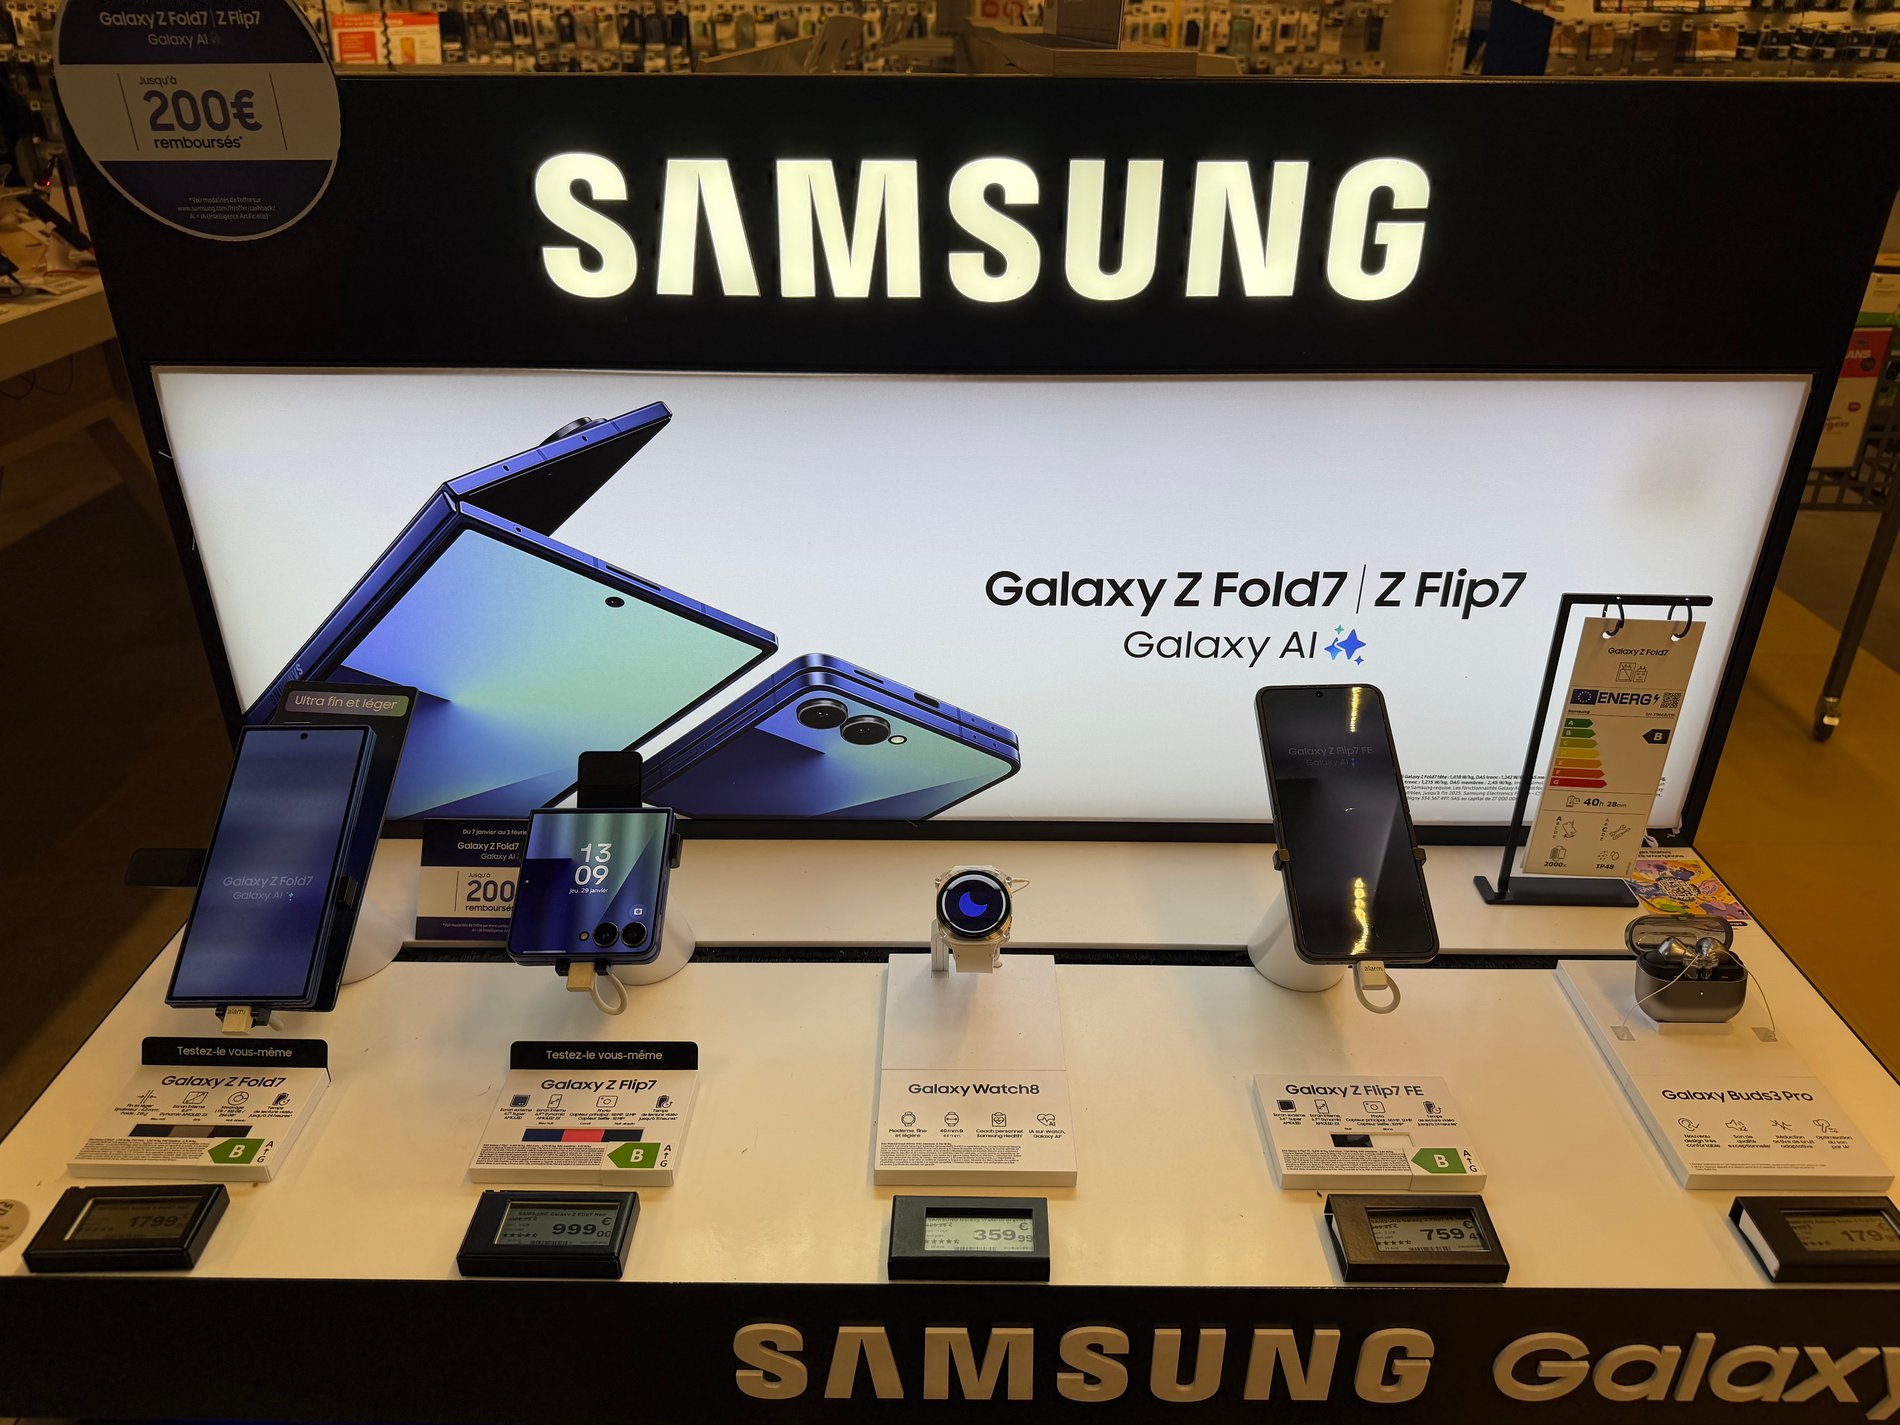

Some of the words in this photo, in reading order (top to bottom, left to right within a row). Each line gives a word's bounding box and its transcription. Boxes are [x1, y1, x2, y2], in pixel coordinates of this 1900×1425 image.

[100, 10, 154, 30] Galaxy
[156, 11, 168, 26] Z
[168, 10, 209, 26] Fold7
[216, 11, 227, 26] Z
[228, 10, 261, 30] Flip7
[148, 33, 194, 48] Galaxy
[196, 33, 209, 45] AI
[143, 89, 262, 132] 200€
[533, 151, 1432, 303] SAMSUNG
[986, 570, 1168, 616] Galaxy
[1172, 571, 1202, 608] Z
[1212, 570, 1348, 608] Fold7
[1374, 571, 1406, 608] Z
[1415, 568, 1528, 620] Flip7
[1122, 630, 1272, 668] Galaxy
[1279, 630, 1318, 659] AI
[1608, 647, 1639, 656] Galaxy
[1646, 648, 1669, 656] Fold7
[294, 695, 325, 706] Ultra
[327, 696, 344, 708] fin
[346, 698, 360, 708] et
[362, 697, 398, 712] léger
[1654, 732, 1663, 741] B
[1288, 746, 1327, 757] Galaxy
[1328, 746, 1335, 754] Z
[1336, 746, 1359, 756] Flip7
[457, 842, 488, 852] Galaxy
[496, 842, 520, 850] Fold7
[580, 843, 612, 862] 13
[480, 853, 507, 862] Galaxy
[574, 864, 609, 886] 09
[223, 876, 269, 888] Galaxy
[270, 876, 278, 886] Z
[279, 876, 314, 886] Fold7
[232, 890, 272, 902] Galaxy
[176, 1046, 228, 1057] Testez-le
[228, 1045, 292, 1058] vous-même
[546, 1050, 596, 1060] Testez-le
[598, 1050, 662, 1060] vous-même
[161, 1074, 224, 1089] Galaxy
[224, 1076, 238, 1086] Z
[238, 1076, 286, 1088] Fold7
[541, 1079, 602, 1093] Galaxy
[605, 1080, 618, 1090] Z
[619, 1078, 658, 1093] Flip7
[908, 1084, 970, 1096] Galaxy
[972, 1084, 1040, 1095] Watch8
[1285, 1084, 1348, 1098] Galaxy
[1349, 1086, 1362, 1096] Z
[1364, 1085, 1401, 1098] Flip7
[1404, 1086, 1424, 1096] FE
[1662, 1090, 1725, 1102] Galaxy
[1726, 1090, 1782, 1102] Buds3
[1782, 1091, 1814, 1102] Pro
[228, 1144, 244, 1158] B
[630, 1148, 644, 1162] B
[1463, 1149, 1472, 1157] A
[256, 1155, 264, 1163] G
[660, 1160, 668, 1168] G
[1432, 1154, 1450, 1168] B
[1468, 1164, 1478, 1172] G
[602, 1216, 612, 1226] €
[1019, 1222, 1029, 1231] €
[552, 1224, 597, 1235] 999
[974, 1229, 1016, 1240] 359
[1420, 1228, 1464, 1240] 759
[1018, 1234, 1032, 1242] 99
[1840, 1230, 1884, 1242] 179
[732, 1324, 1435, 1402] SAMSUNG
